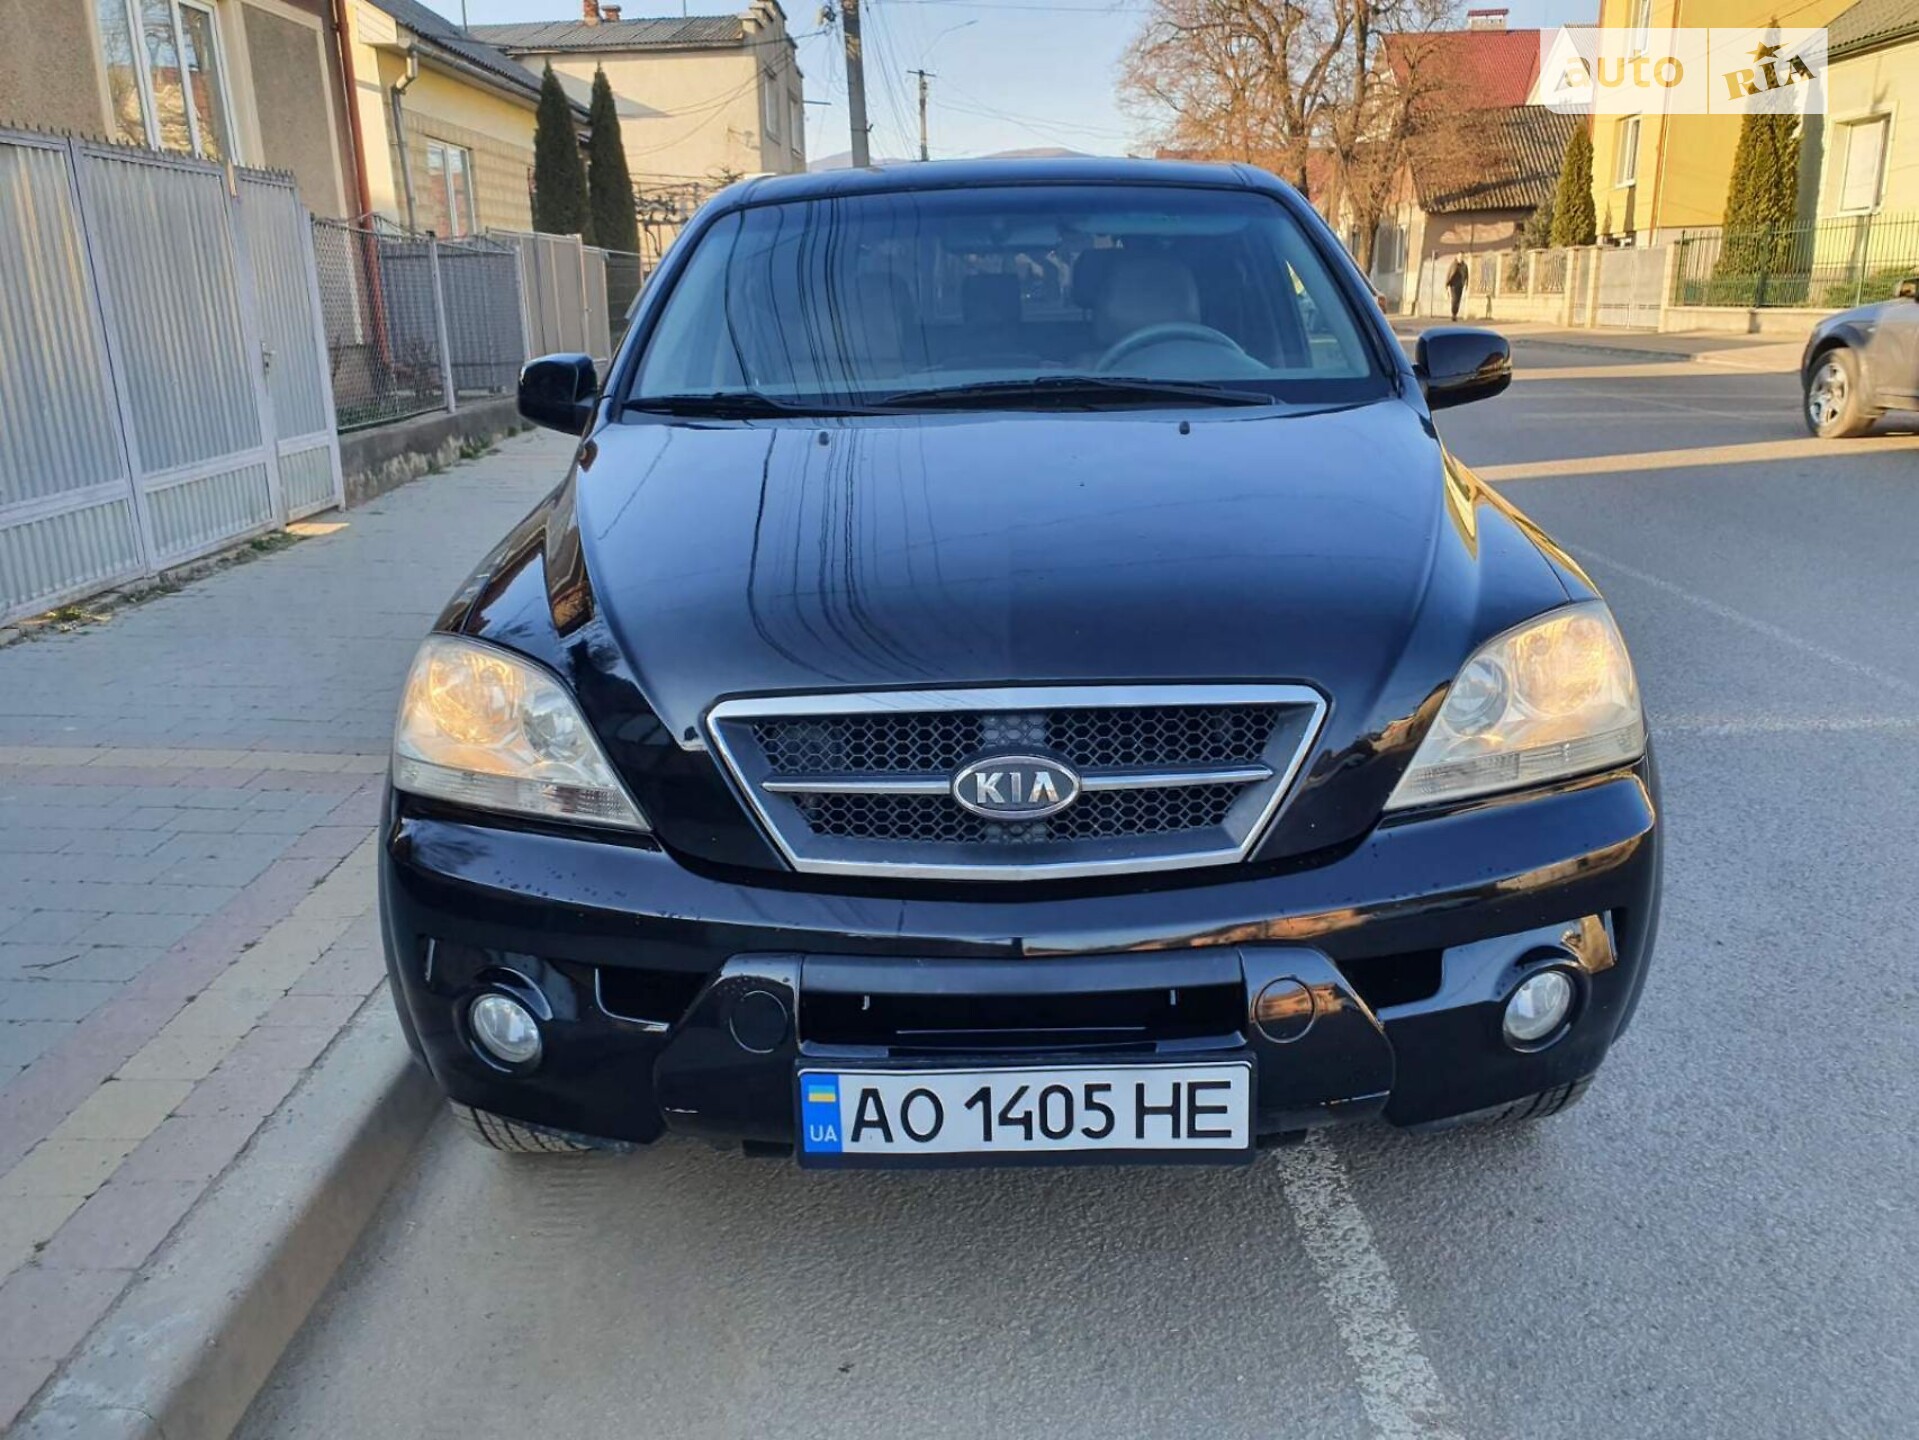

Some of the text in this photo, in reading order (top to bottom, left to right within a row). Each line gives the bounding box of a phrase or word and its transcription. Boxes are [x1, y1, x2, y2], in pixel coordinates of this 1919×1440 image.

[975, 771, 1060, 804] KIA
[850, 1080, 1232, 1143] AO 1405 HE
[810, 1124, 838, 1143] UA
